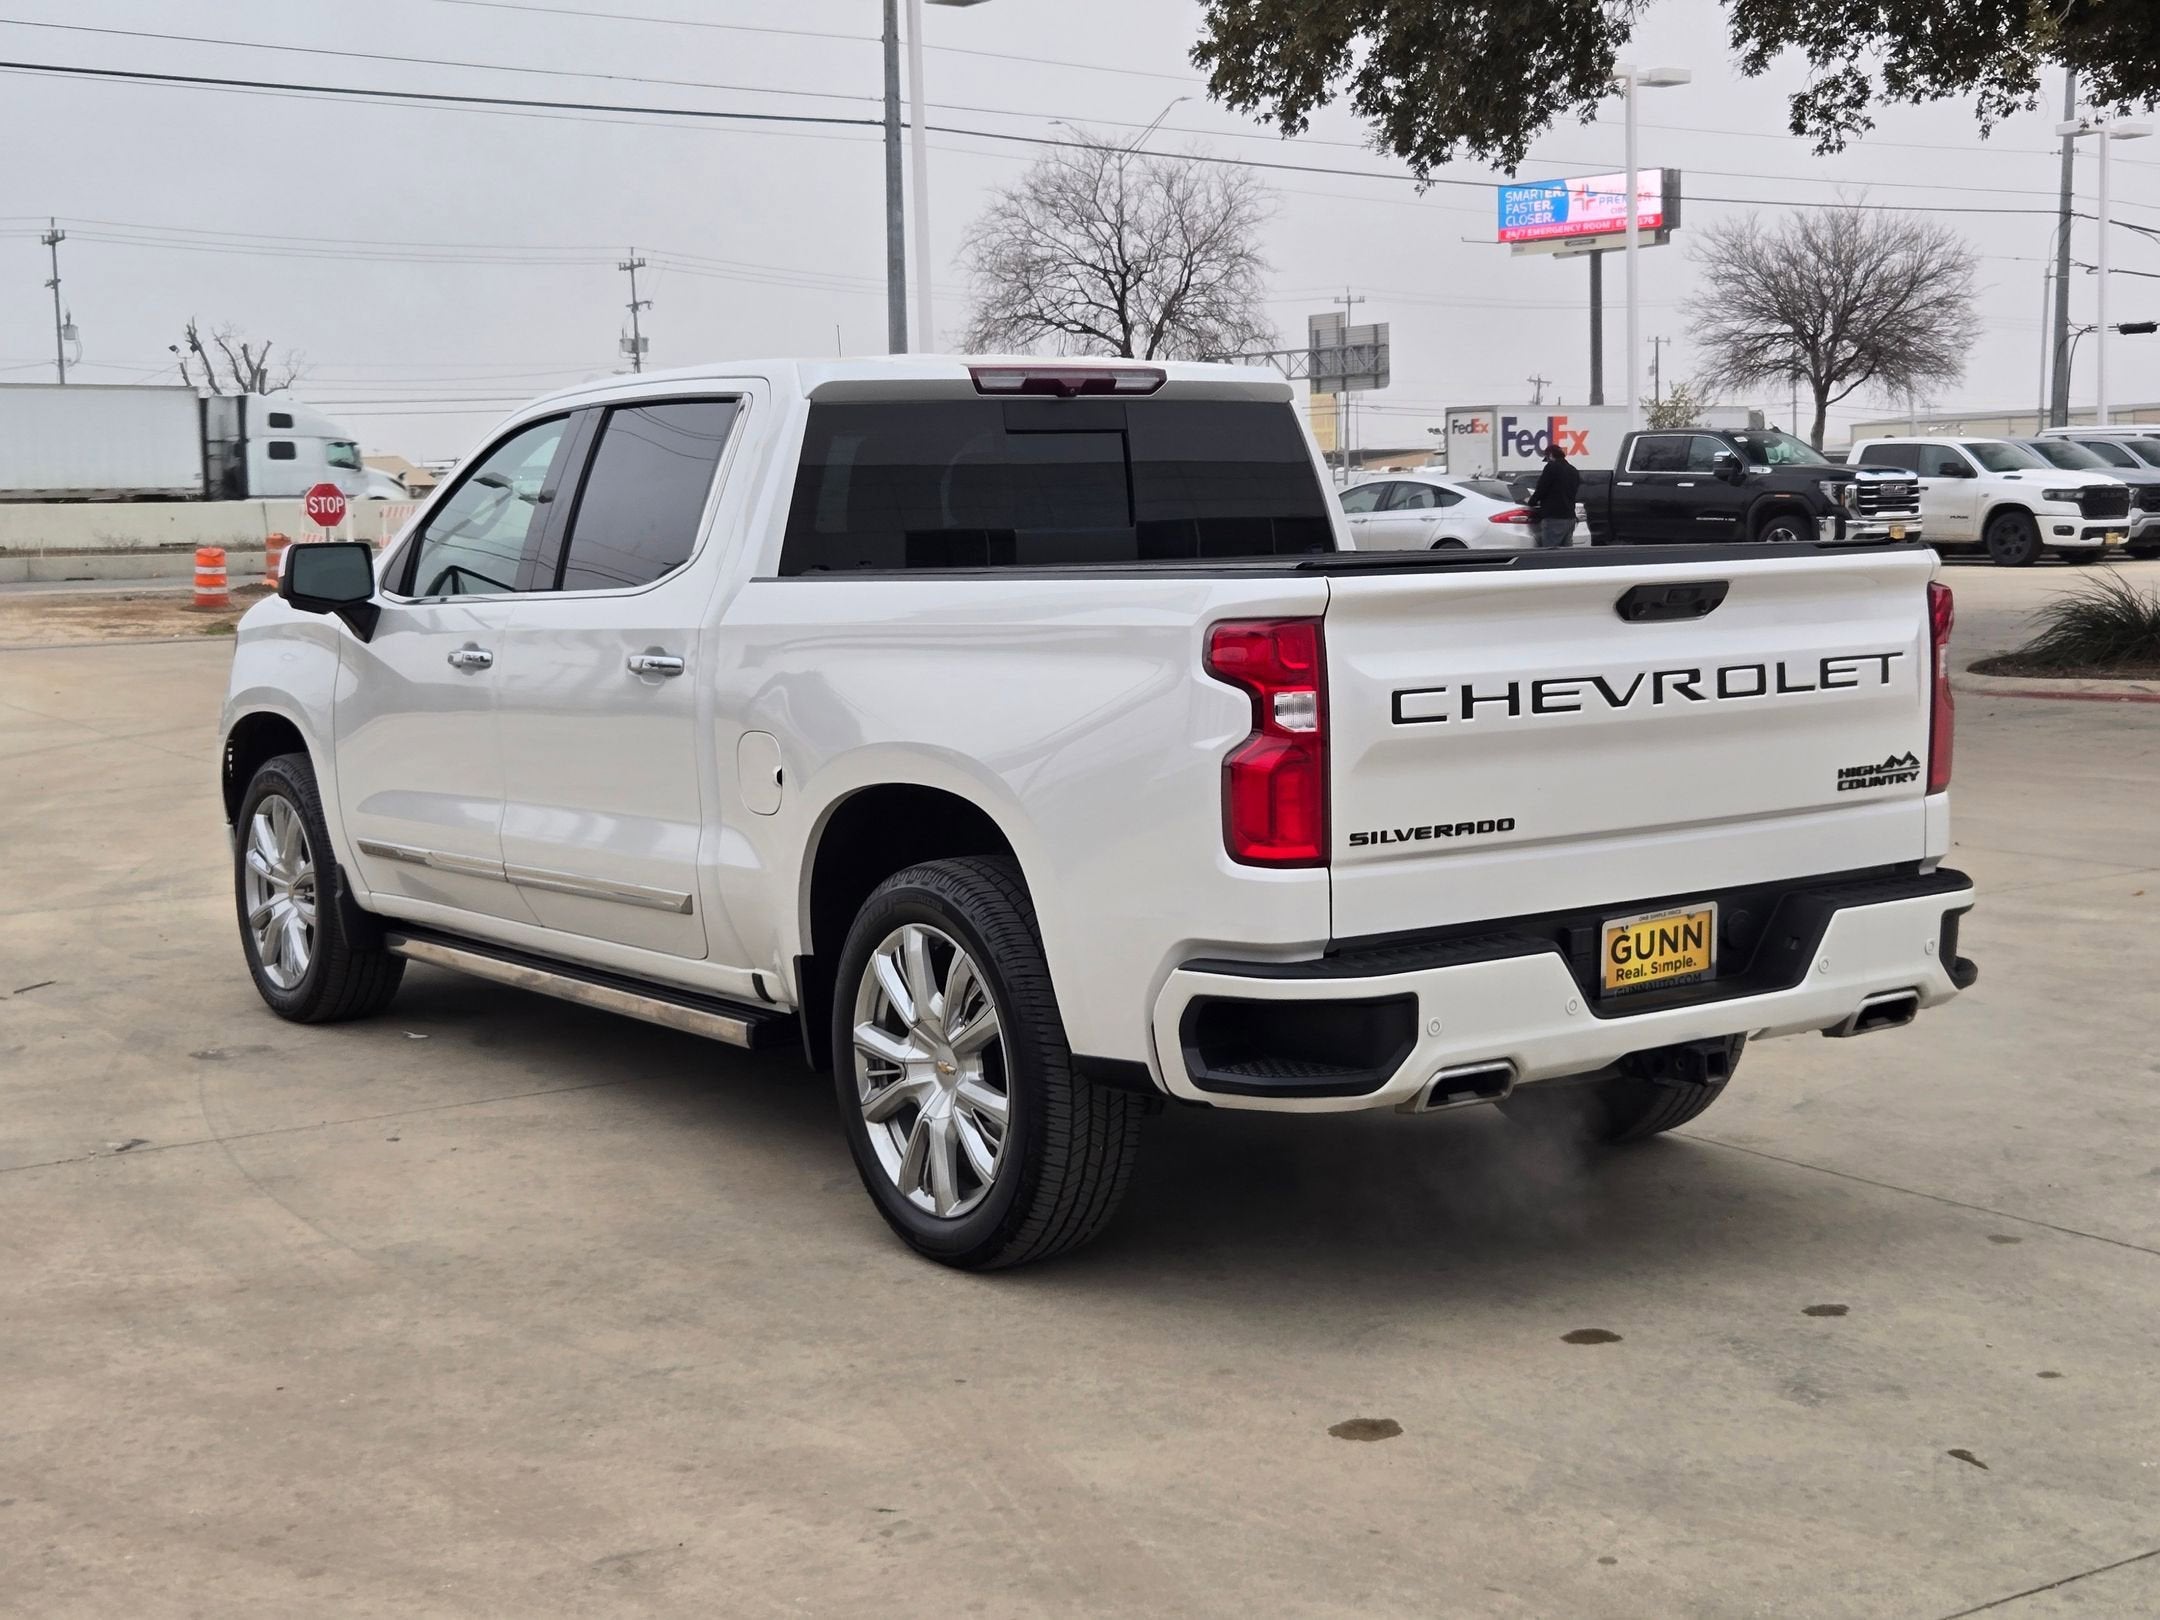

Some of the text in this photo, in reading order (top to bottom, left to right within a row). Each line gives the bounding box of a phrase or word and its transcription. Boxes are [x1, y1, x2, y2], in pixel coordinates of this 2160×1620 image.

[1505, 186, 1566, 203] SMARTER.
[1505, 200, 1555, 215] FASTER.
[1505, 212, 1556, 227] CLOSER.
[1527, 223, 1581, 237] EMERGENCY
[1583, 220, 1611, 231] ROOM
[1452, 418, 1489, 435] FedEx
[1501, 416, 1590, 458] FedEx
[309, 496, 344, 514] STOP
[1391, 652, 1904, 726] CHEVROLET
[1837, 770, 1920, 791] COUNTRY
[1838, 764, 1881, 779] HIGH
[1349, 817, 1515, 846] SILVERADO
[1611, 921, 1702, 964] GUNN
[1615, 963, 1647, 981] Real.
